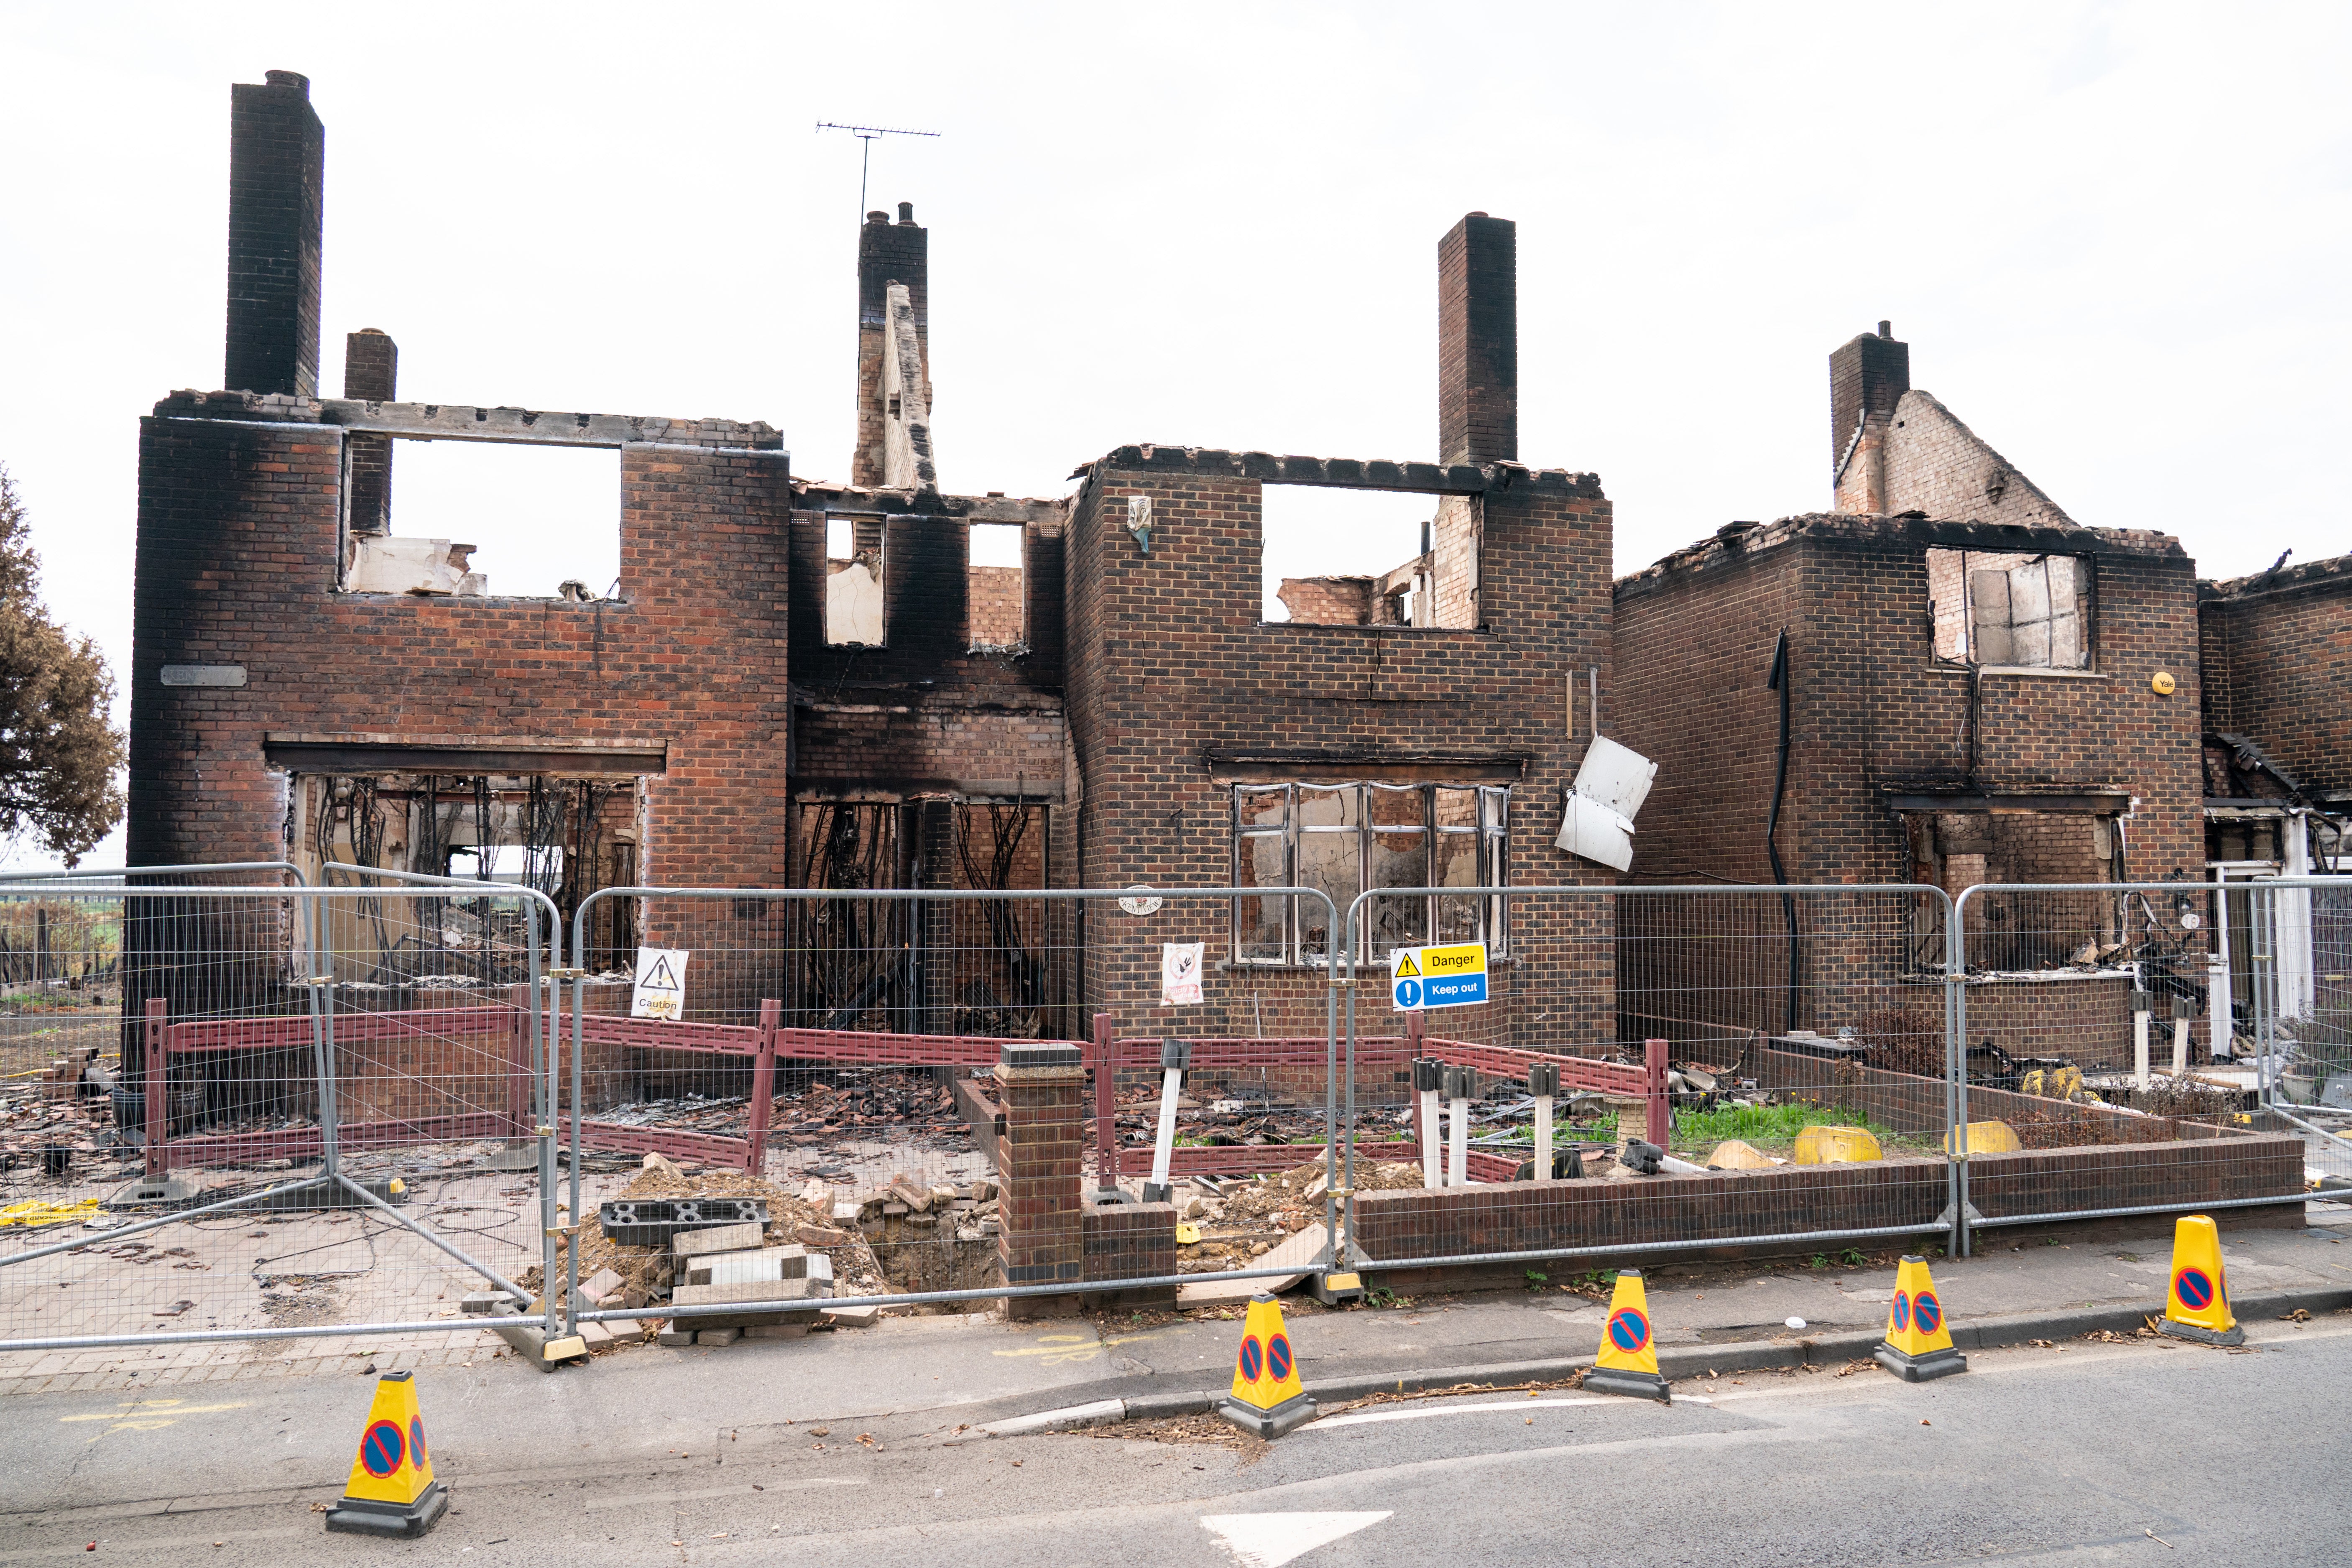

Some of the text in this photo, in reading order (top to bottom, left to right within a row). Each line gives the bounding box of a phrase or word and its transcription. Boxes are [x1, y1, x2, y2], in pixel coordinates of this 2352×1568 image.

[1122, 900, 1159, 913] KENT VIEW
[1432, 955, 1475, 967] Danger
[1432, 983, 1478, 996] Keep out
[639, 999, 677, 1009] Caution
